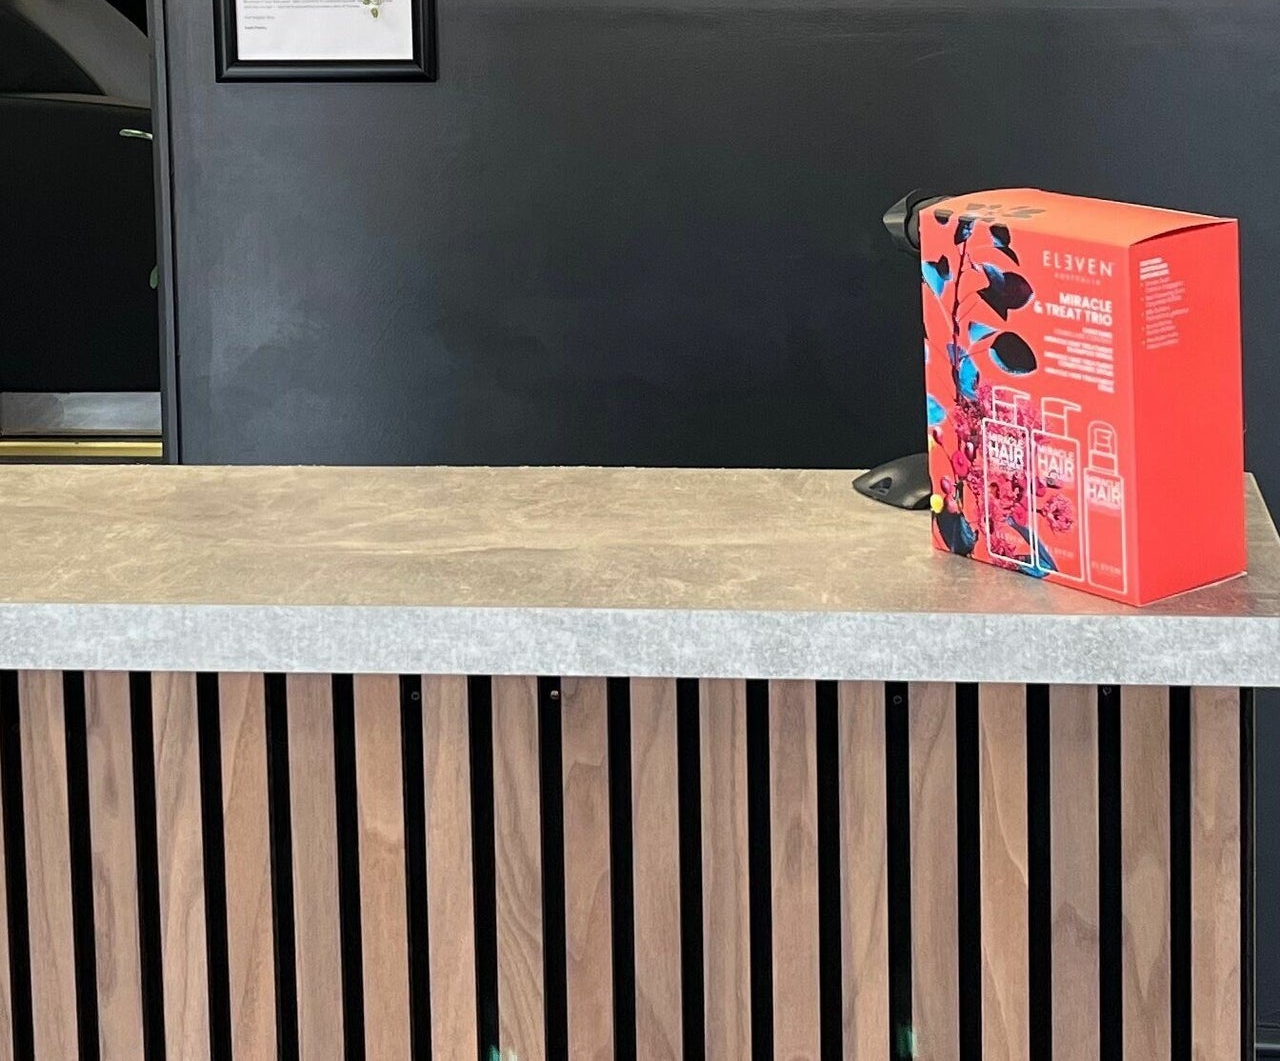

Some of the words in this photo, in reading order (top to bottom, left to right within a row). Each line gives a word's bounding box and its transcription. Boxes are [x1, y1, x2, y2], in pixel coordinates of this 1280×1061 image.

[1033, 300, 1043, 314] &
[1046, 302, 1082, 321] TREAT
[1084, 309, 1113, 327] TRIO
[1059, 292, 1112, 314] MIRACLE
[988, 440, 1024, 465] HAIR
[1038, 451, 1076, 478] HAIR
[1087, 481, 1121, 506] HAIR
